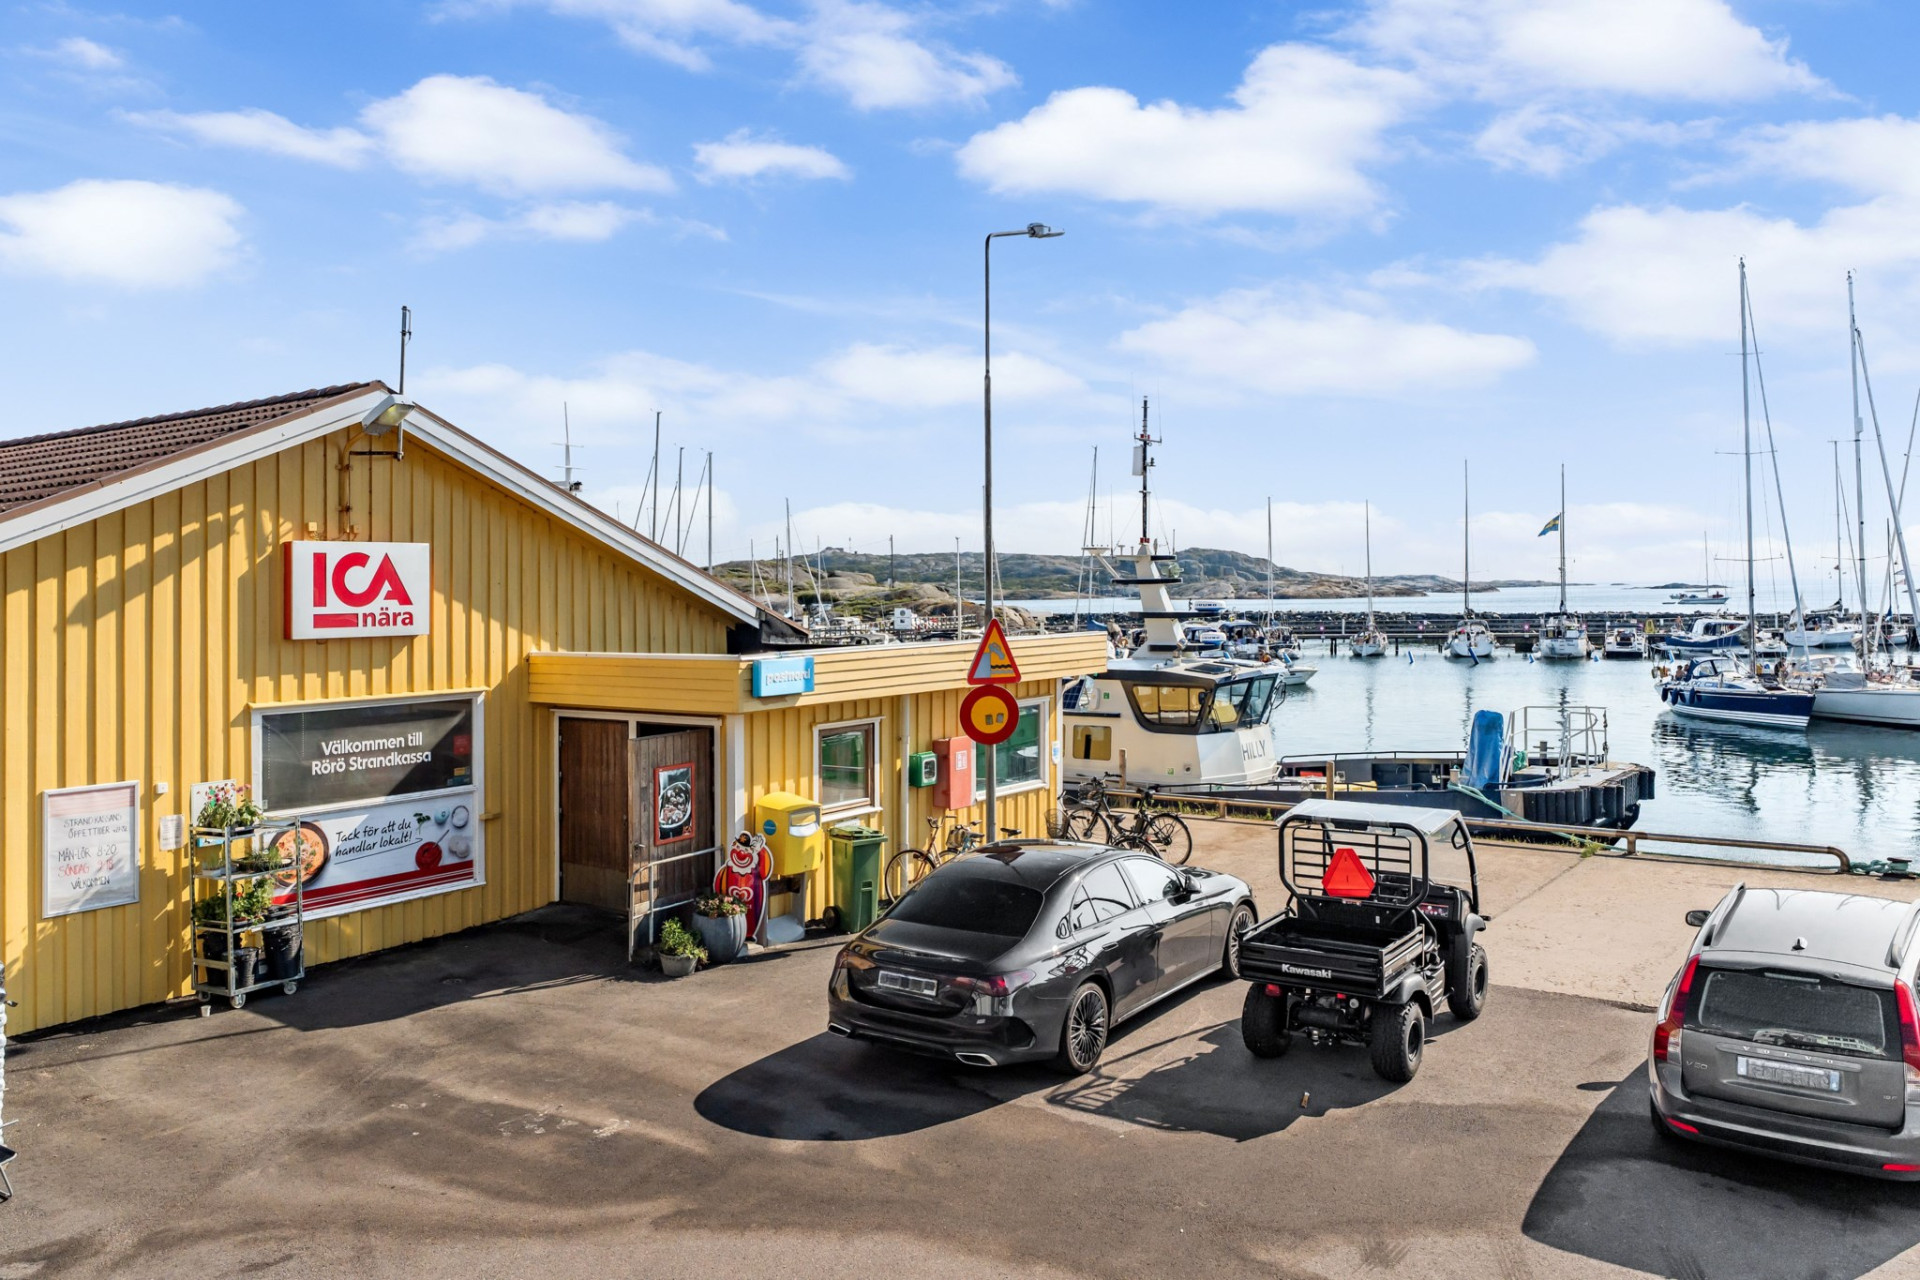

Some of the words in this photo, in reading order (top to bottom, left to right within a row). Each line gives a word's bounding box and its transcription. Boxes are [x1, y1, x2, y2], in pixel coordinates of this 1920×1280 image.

[313, 552, 413, 607] ICA
[362, 607, 414, 627] nära
[766, 668, 811, 686] postnord
[321, 737, 405, 756] Välkommen
[407, 732, 423, 747] till
[1242, 740, 1265, 760] HILLY
[312, 757, 346, 776] Rörö
[348, 751, 431, 771] Strandkassa
[335, 828, 360, 842] Tack
[362, 826, 379, 838] för
[381, 821, 396, 834] att
[397, 818, 412, 831] du
[334, 842, 376, 857] handlar
[379, 831, 413, 847] lokalt!
[1281, 963, 1332, 979] Kawasaki
[1743, 1046, 1834, 1064] VOLVO
